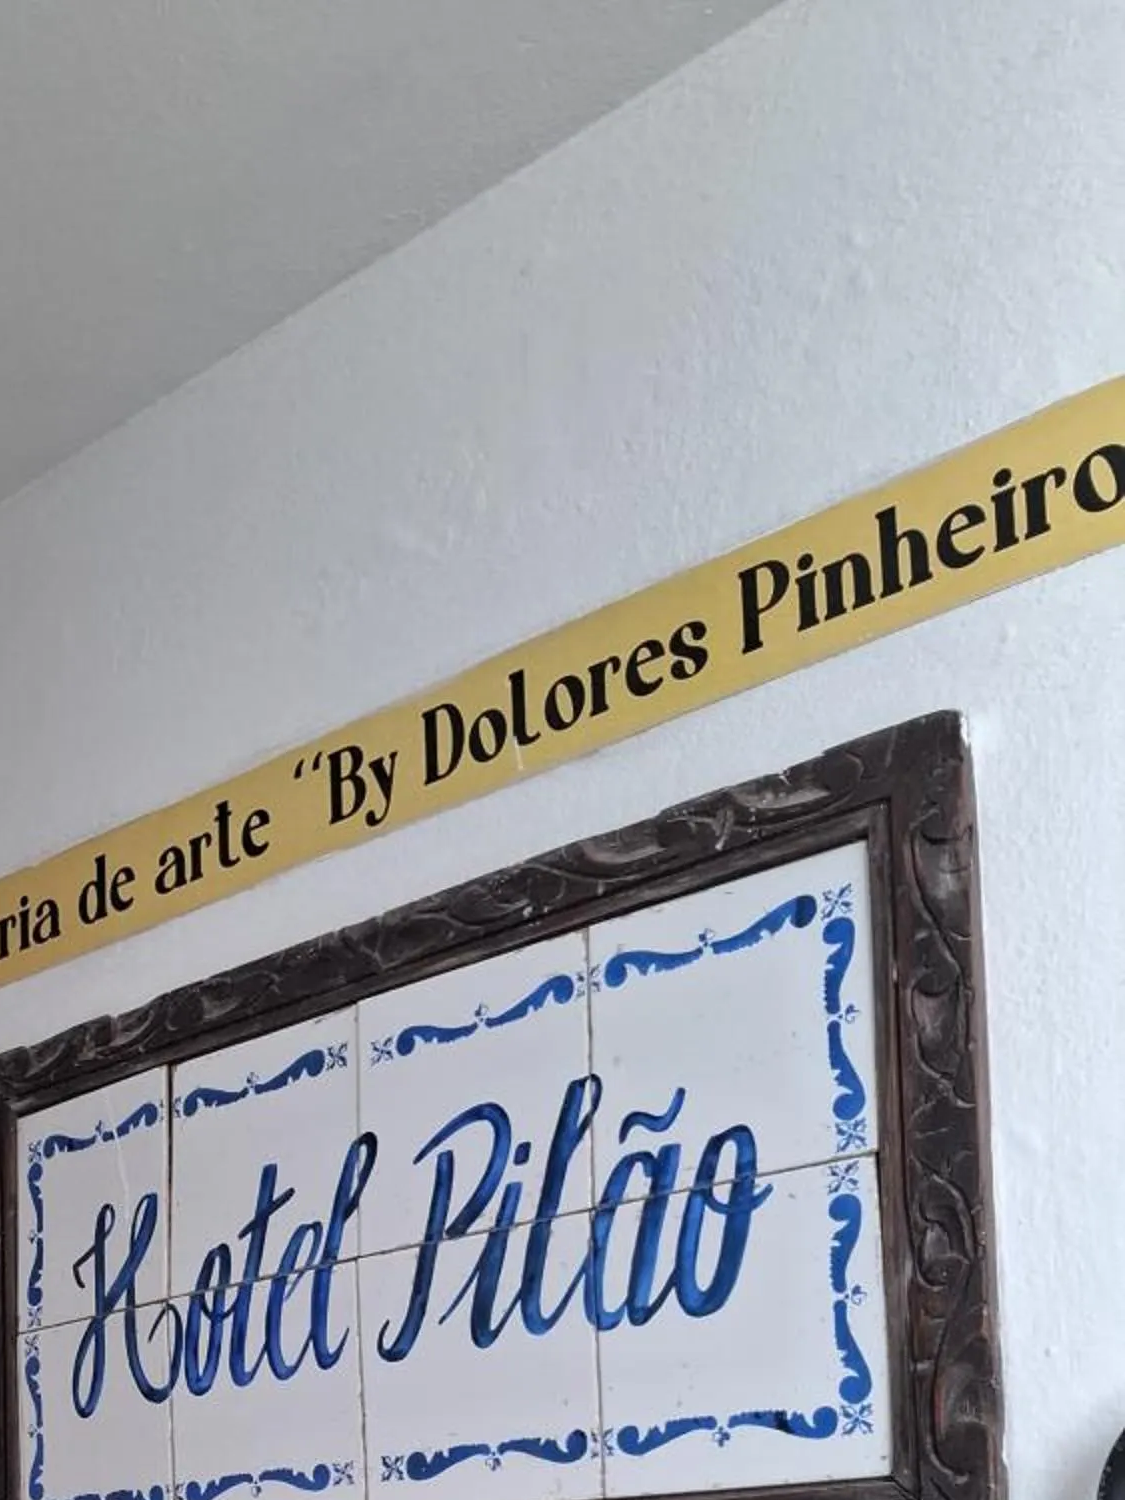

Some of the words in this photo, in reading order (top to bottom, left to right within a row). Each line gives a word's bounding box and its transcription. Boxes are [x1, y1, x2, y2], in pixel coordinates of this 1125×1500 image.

[77, 853, 135, 925] de
[154, 800, 271, 896] arte
[421, 619, 709, 786] Dolores
[737, 442, 1125, 655] Pinheiro
[73, 1131, 379, 1418] Hotel
[377, 1073, 773, 1363] Pilão
